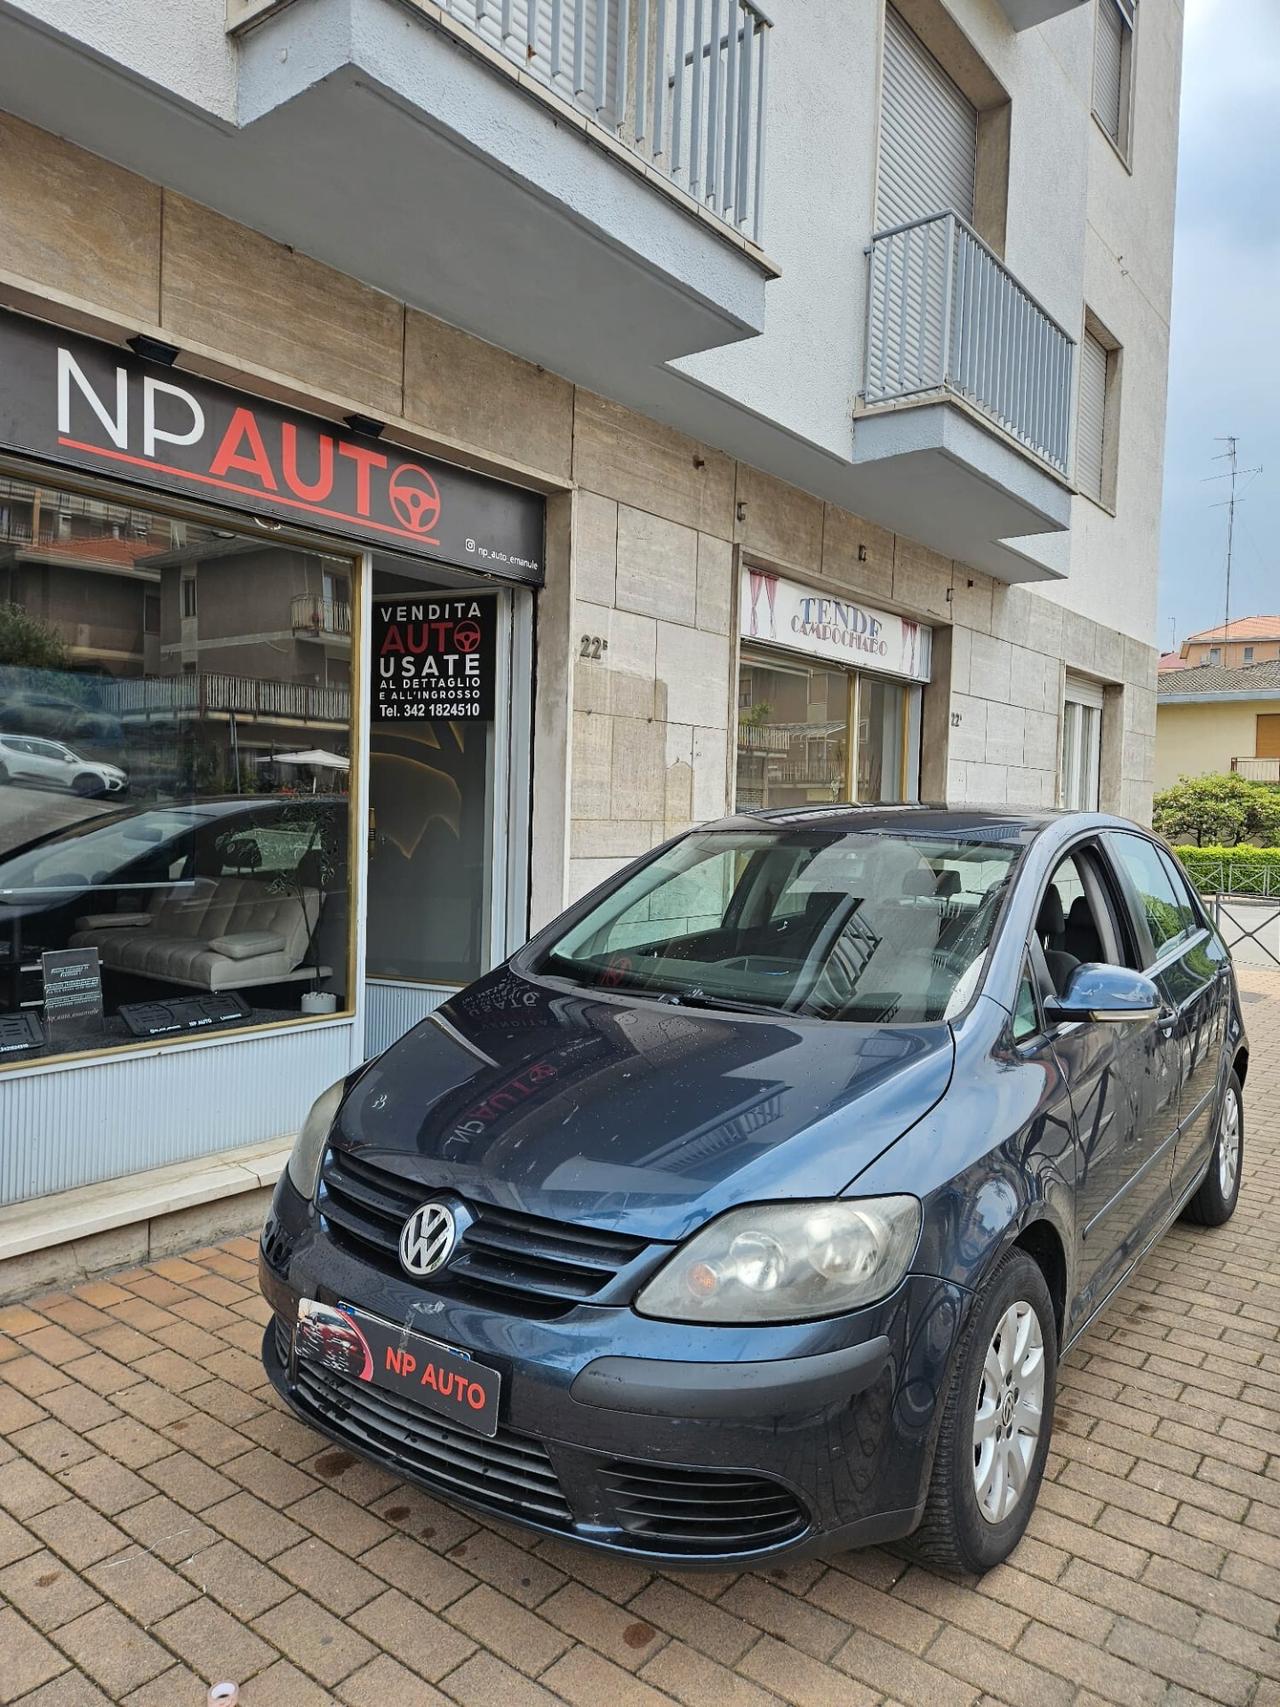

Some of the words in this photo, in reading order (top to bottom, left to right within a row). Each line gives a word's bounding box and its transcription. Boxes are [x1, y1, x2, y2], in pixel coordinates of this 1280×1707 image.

[381, 602, 481, 622] VENDITA
[379, 654, 481, 678] USATE
[380, 679, 396, 689] AL
[403, 677, 481, 689] DETTAGLIO
[379, 692, 385, 700] E
[391, 690, 481, 700] ALL'INGROSSO
[379, 704, 400, 717] Tel.
[404, 703, 425, 717] 342
[428, 703, 480, 716] 1824510
[385, 1346, 416, 1376] NP
[421, 1363, 486, 1409] AUTO
